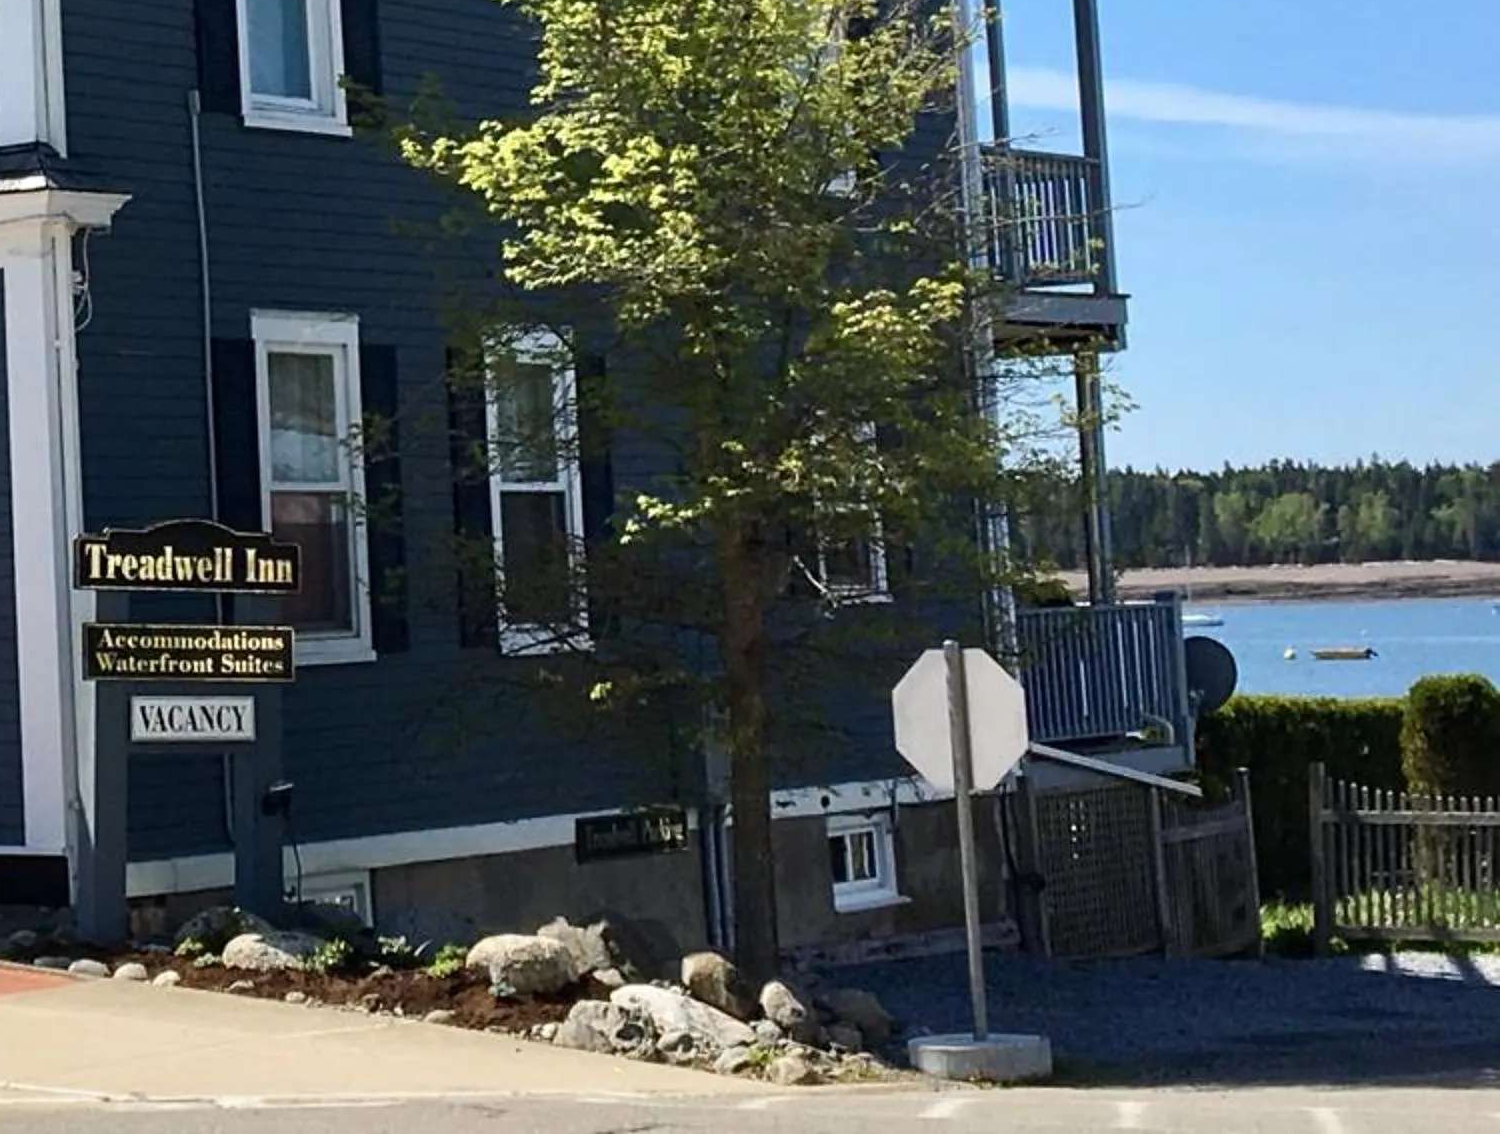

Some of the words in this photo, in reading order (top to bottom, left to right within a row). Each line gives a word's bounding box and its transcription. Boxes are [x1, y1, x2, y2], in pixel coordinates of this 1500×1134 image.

[85, 542, 233, 583] Treadwell
[245, 548, 293, 584] Inn
[99, 628, 285, 652] Accommodations
[96, 652, 214, 675] Waterfront
[220, 654, 285, 674] Suites
[139, 704, 248, 733] VACANCY
